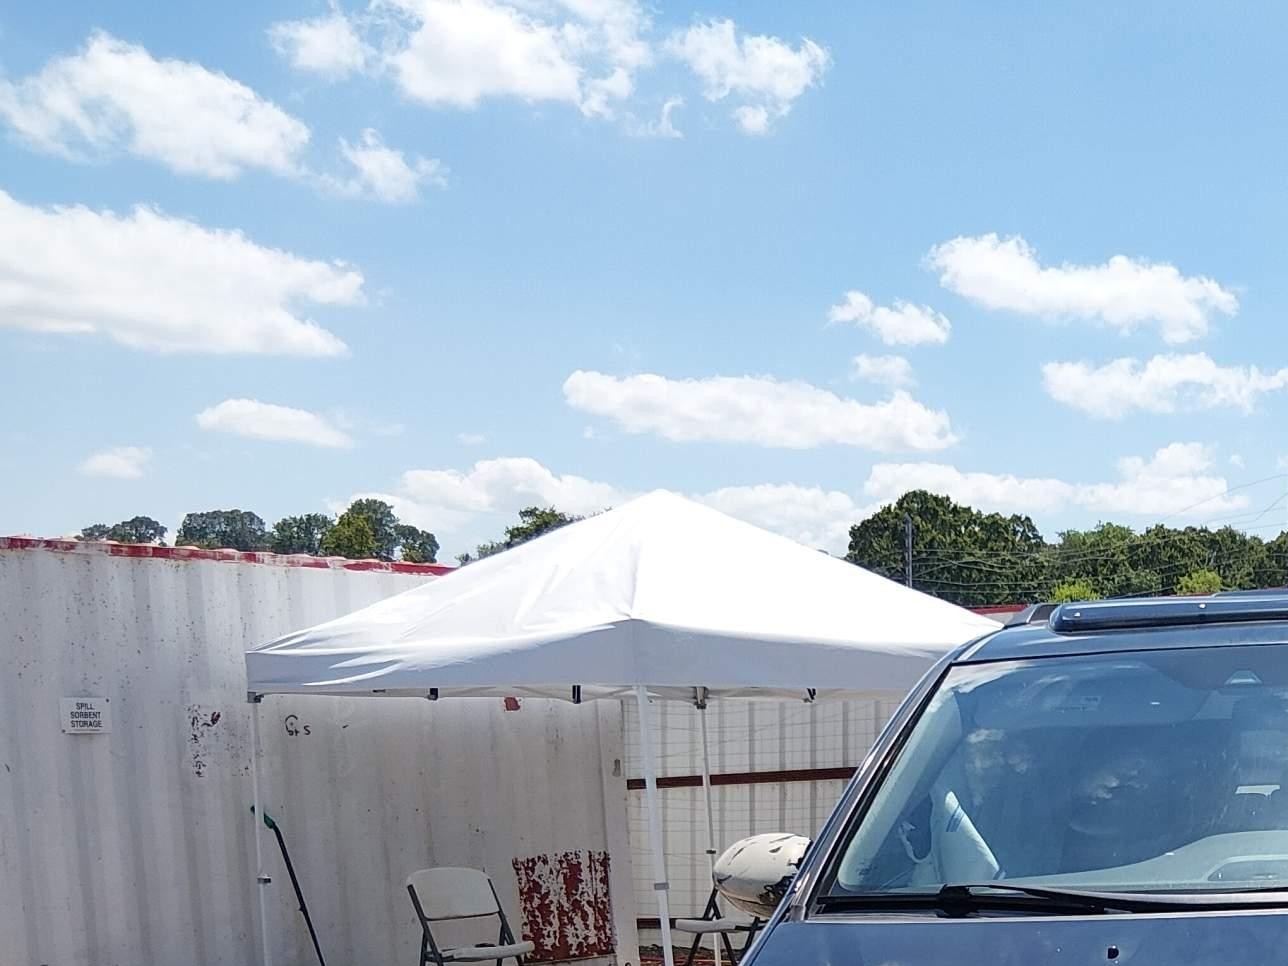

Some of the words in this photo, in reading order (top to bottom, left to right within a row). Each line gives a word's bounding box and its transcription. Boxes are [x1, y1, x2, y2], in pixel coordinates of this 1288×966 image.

[76, 702, 94, 710] SPILL
[70, 711, 101, 719] SORBENT
[71, 720, 103, 728] STORAGE
